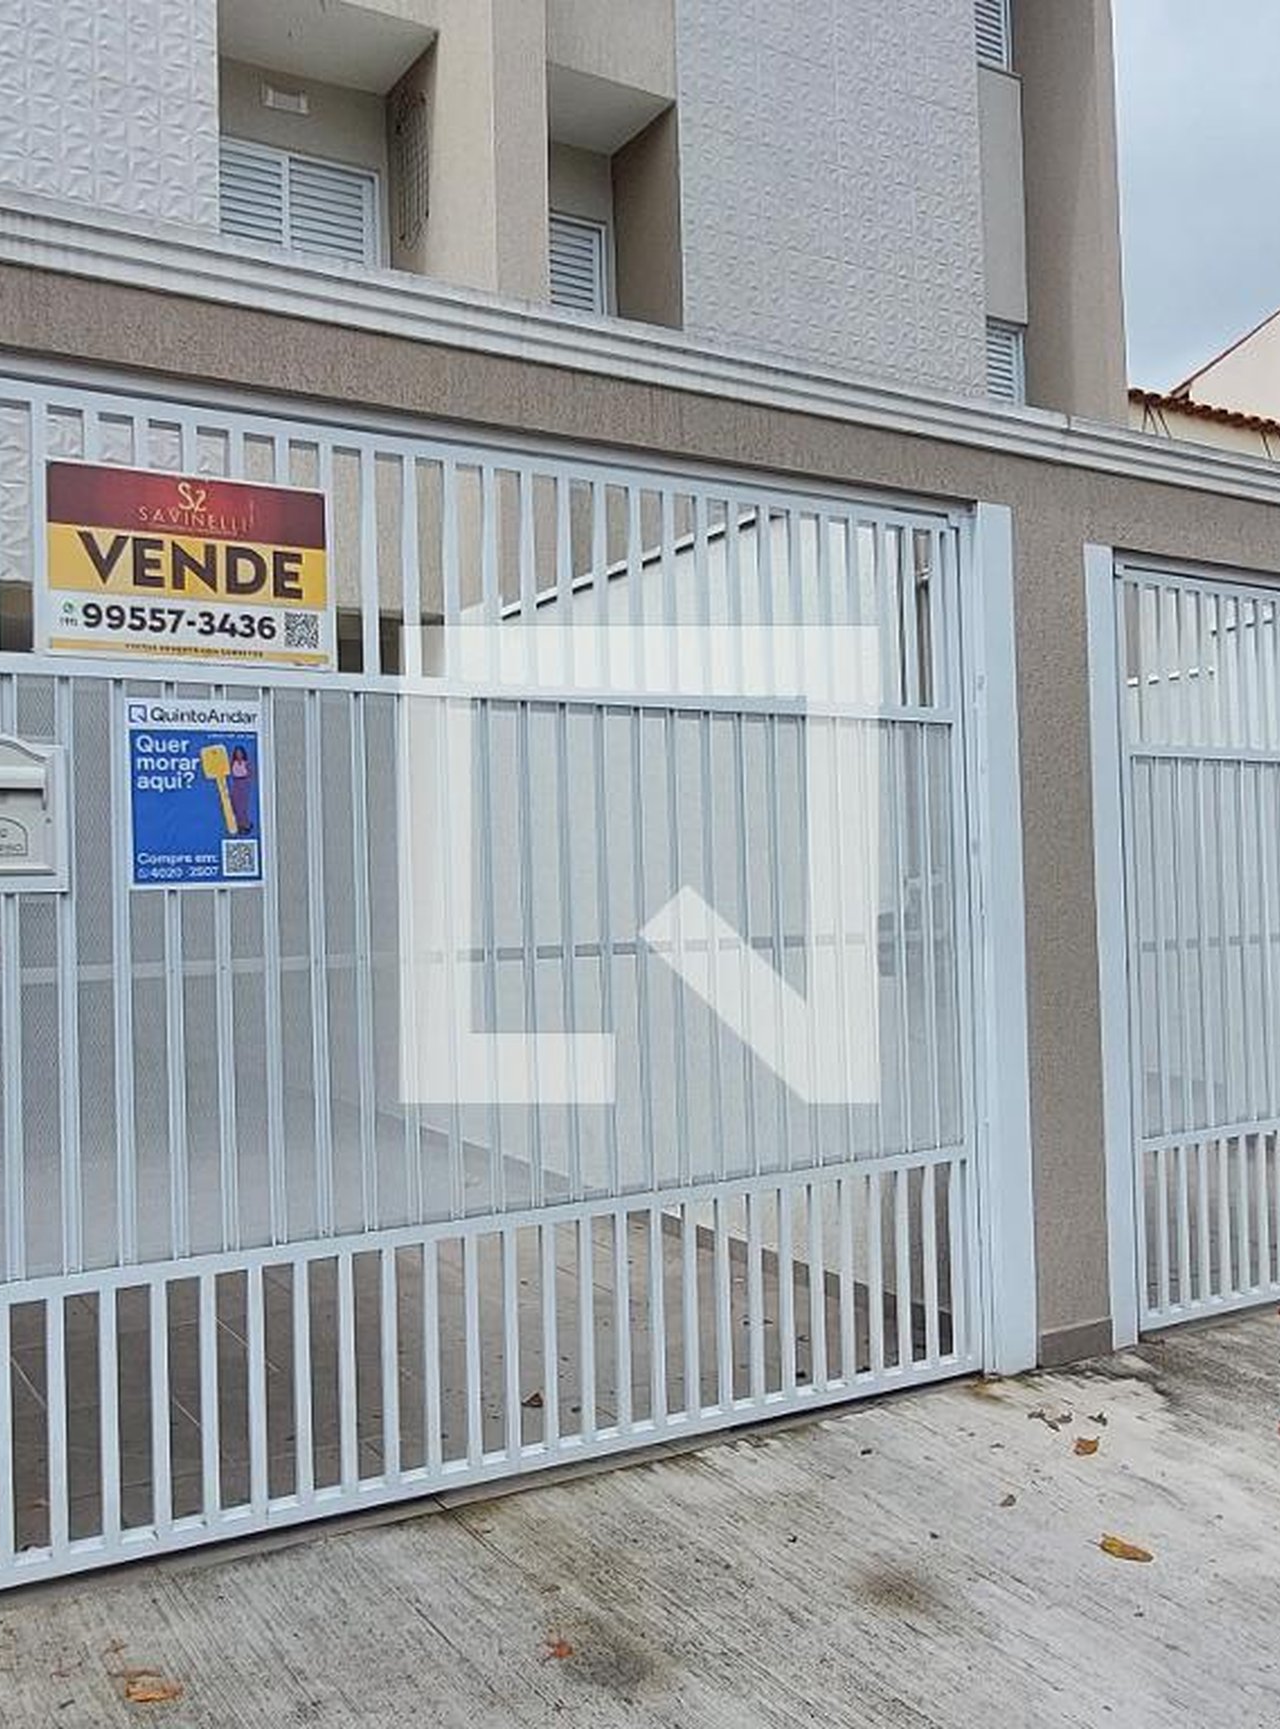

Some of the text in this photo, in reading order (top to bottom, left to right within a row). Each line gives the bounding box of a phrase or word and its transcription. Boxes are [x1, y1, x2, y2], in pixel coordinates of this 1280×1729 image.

[77, 531, 302, 600] VENDE
[82, 602, 276, 640] 99557-3436
[150, 706, 257, 724] QuintoAndar
[136, 735, 189, 752] Quer
[136, 756, 199, 771] morar
[136, 771, 194, 792] aqui?
